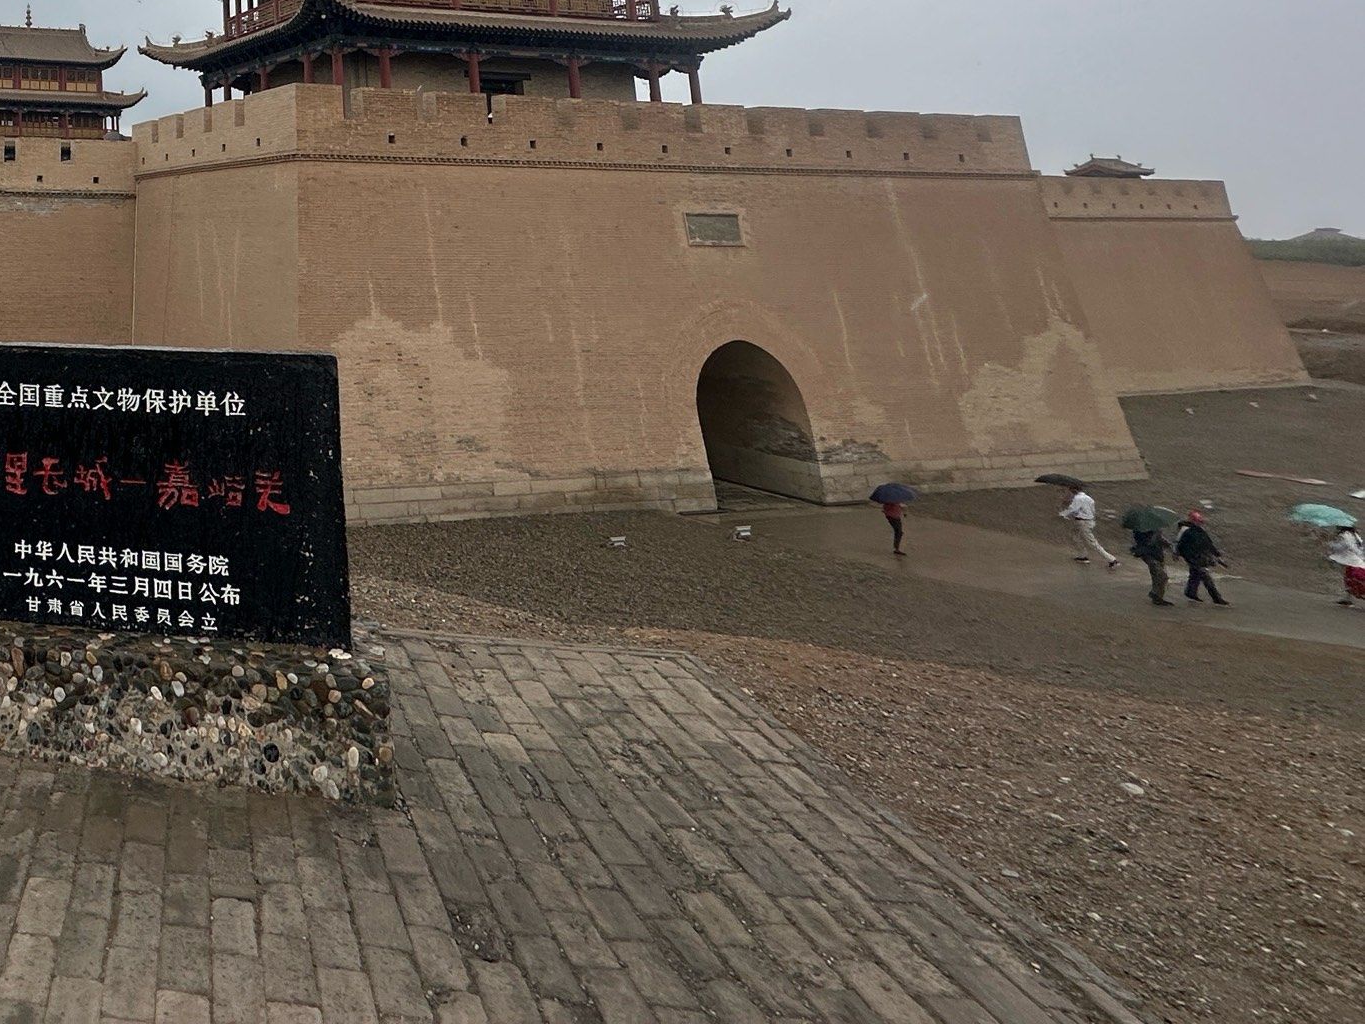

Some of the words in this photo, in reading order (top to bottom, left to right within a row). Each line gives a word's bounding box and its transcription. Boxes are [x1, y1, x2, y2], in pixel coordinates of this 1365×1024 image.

[14, 539, 229, 576] 中华人民共和国国务院
[3, 567, 241, 606] 一九六一年三月四日公布
[26, 596, 218, 631] 甘肃省人民委员会立
